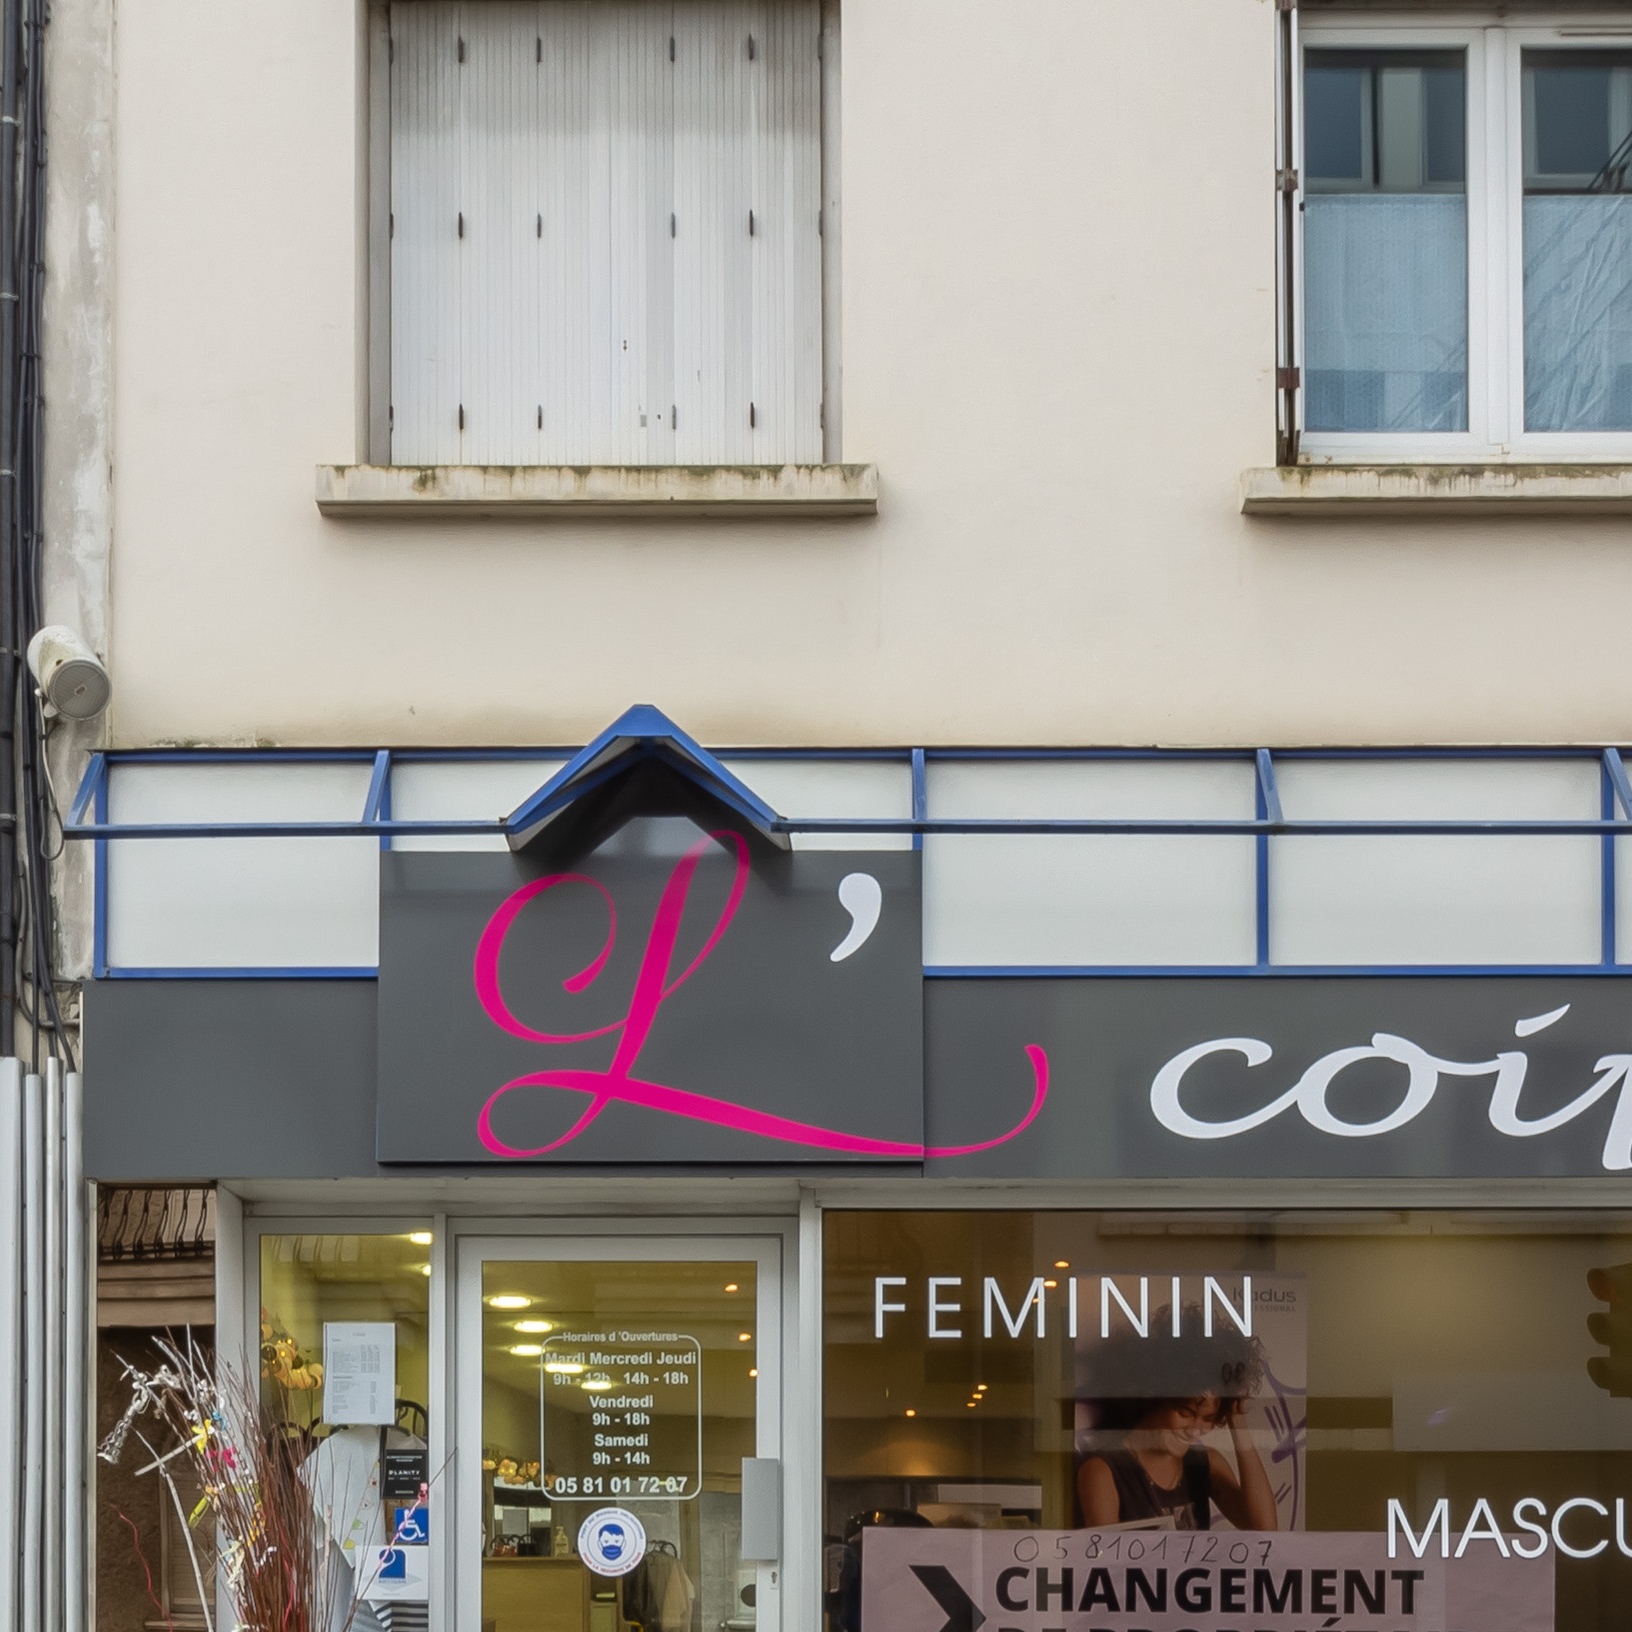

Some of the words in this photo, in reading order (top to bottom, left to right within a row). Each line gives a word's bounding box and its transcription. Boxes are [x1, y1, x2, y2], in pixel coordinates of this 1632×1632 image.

[874, 1275, 1254, 1339] FEMININ
[562, 1332, 606, 1342] Horaires
[545, 1352, 585, 1364] Mardi
[589, 1352, 653, 1365] Mercredi
[656, 1352, 697, 1365] Jeudi
[553, 1373, 571, 1386] 9h
[623, 1372, 649, 1385] 14h
[663, 1372, 689, 1385] 18h
[589, 1395, 654, 1408] Vendredi
[592, 1412, 610, 1426] 9h
[624, 1412, 650, 1426] 18h
[594, 1433, 649, 1447] Samedi
[592, 1452, 610, 1465] 9h
[624, 1452, 650, 1465] 14h
[555, 1477, 577, 1494] 05
[582, 1477, 603, 1494] 81
[610, 1477, 631, 1494] 01
[638, 1477, 660, 1494] 72
[665, 1476, 688, 1494] 07
[995, 1567, 1425, 1616] CHANGEMENT
